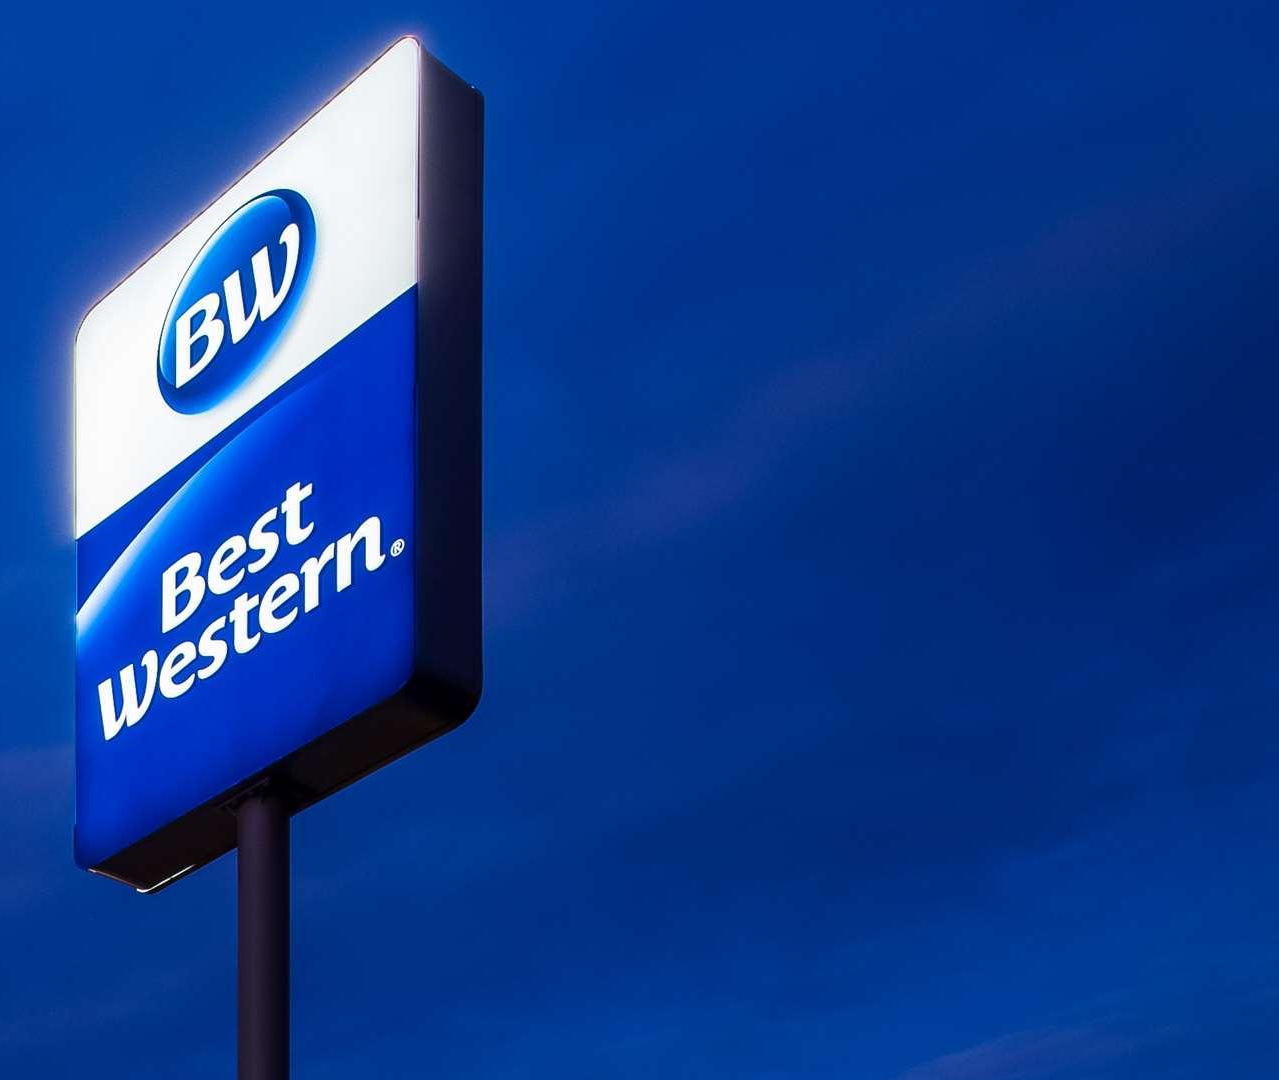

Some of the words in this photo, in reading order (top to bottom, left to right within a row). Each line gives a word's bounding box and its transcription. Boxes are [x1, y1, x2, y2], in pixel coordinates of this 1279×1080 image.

[175, 223, 300, 389] BW
[97, 515, 387, 741] Western
[161, 481, 315, 634] Best
